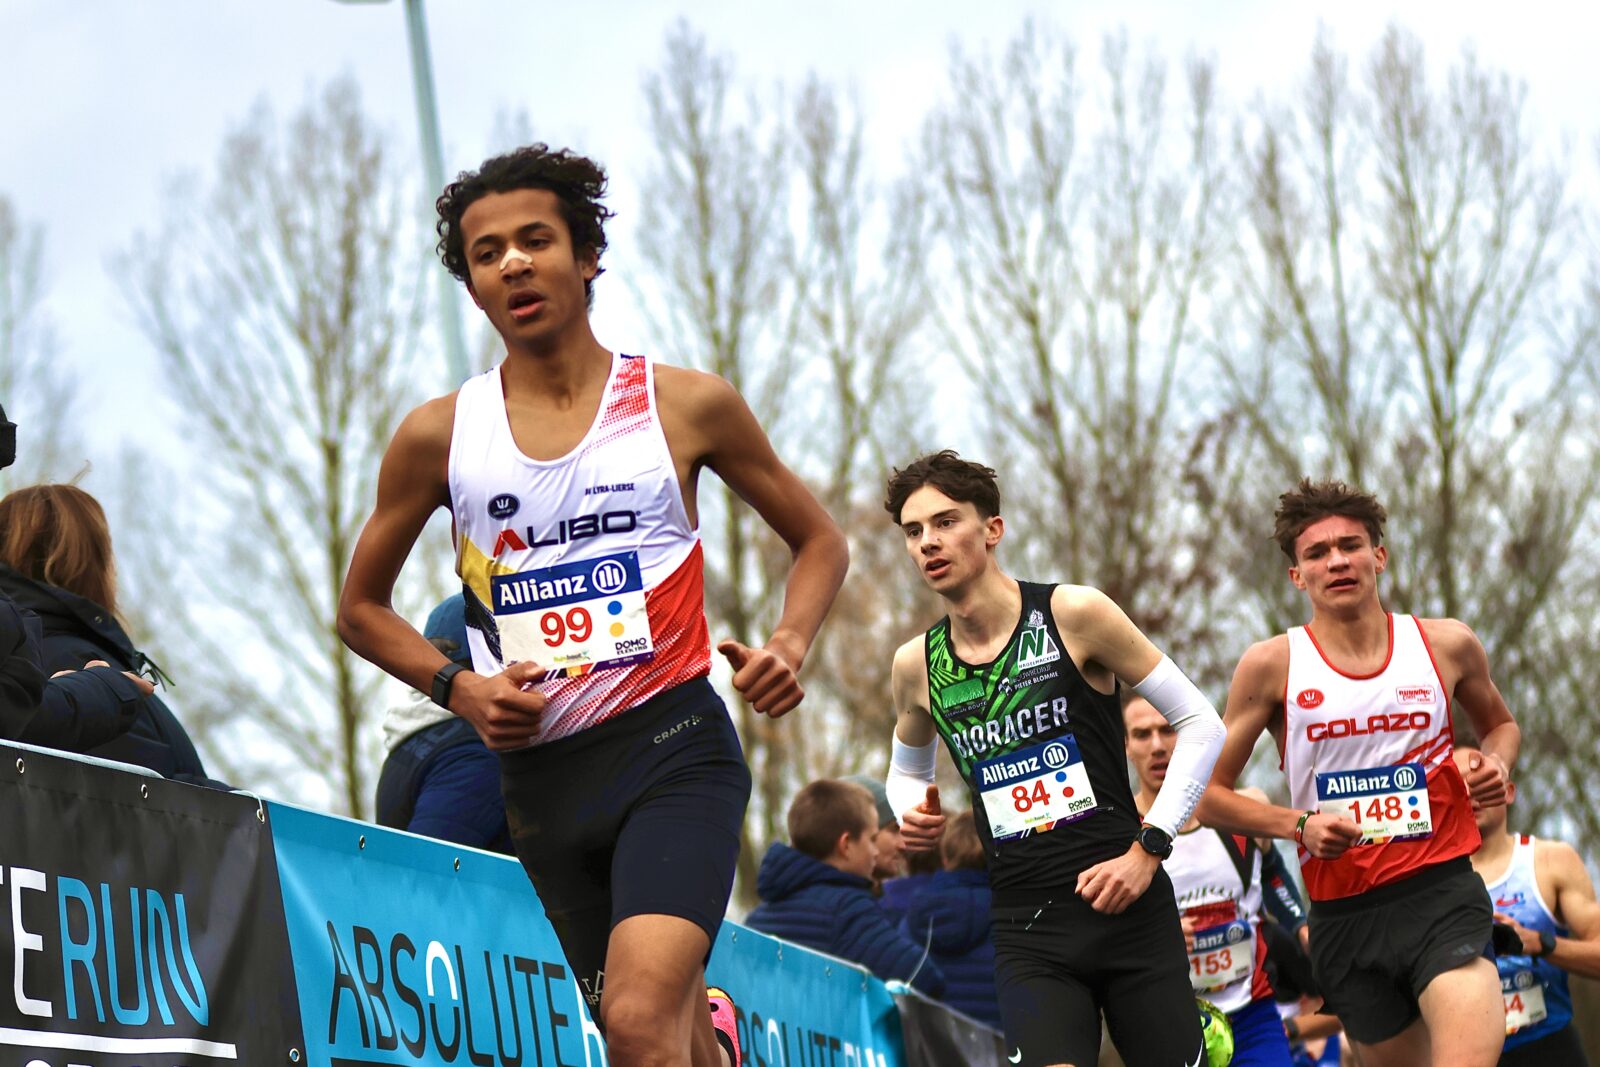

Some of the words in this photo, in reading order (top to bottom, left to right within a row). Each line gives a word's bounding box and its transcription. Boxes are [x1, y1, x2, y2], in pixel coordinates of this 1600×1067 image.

[493, 510, 637, 558] ALIBO
[500, 575, 588, 606] Allianz
[540, 607, 593, 647] 99
[614, 637, 647, 650] DOMO
[653, 720, 690, 744] CRAFT
[952, 697, 1070, 759] BIORACER
[1306, 711, 1431, 742] GOLAZO
[982, 756, 1041, 785] Allianz
[1326, 775, 1391, 795] Allianz
[1011, 780, 1051, 813] 84
[1068, 796, 1092, 809] DOMO
[1348, 796, 1403, 825] 148
[1191, 948, 1233, 977] 153
